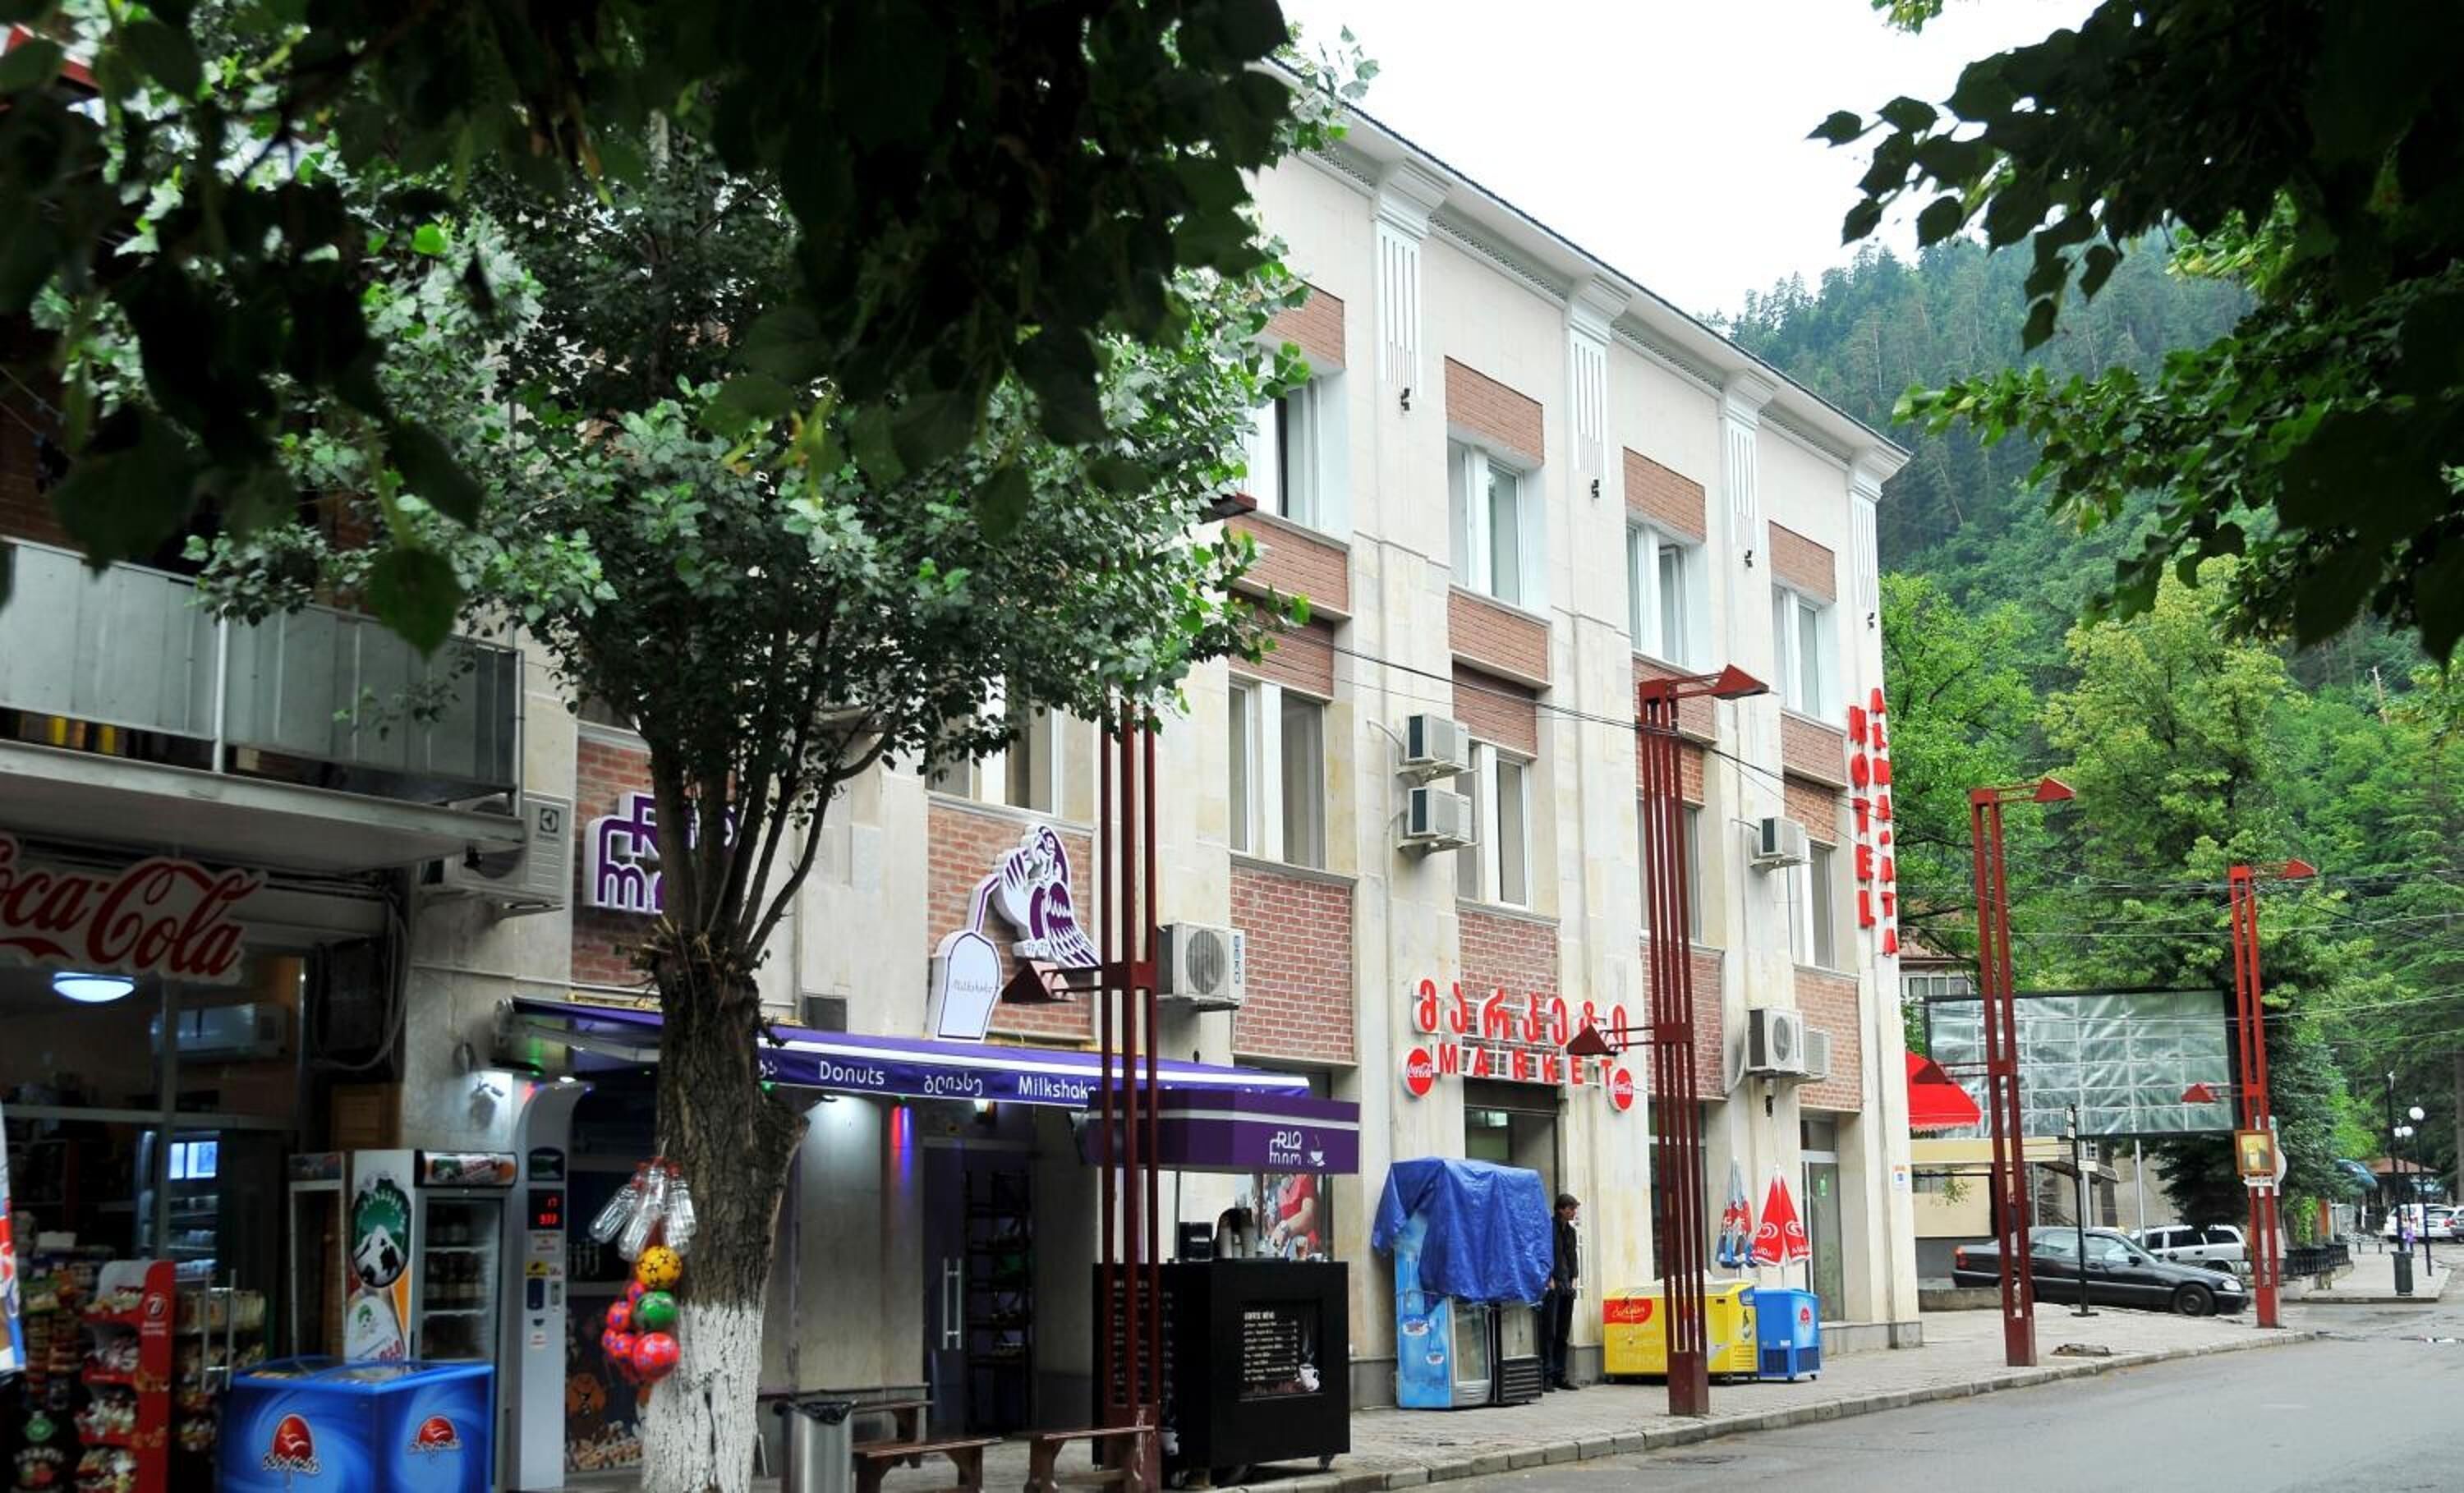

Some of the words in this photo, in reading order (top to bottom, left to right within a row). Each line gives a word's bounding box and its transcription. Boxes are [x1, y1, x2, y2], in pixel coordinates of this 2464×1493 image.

[1850, 706, 1877, 929] HOTEL
[820, 1060, 885, 1086] Donuts
[1437, 1042, 1613, 1086] MARKET
[1018, 1076, 1096, 1100] Milkshak
